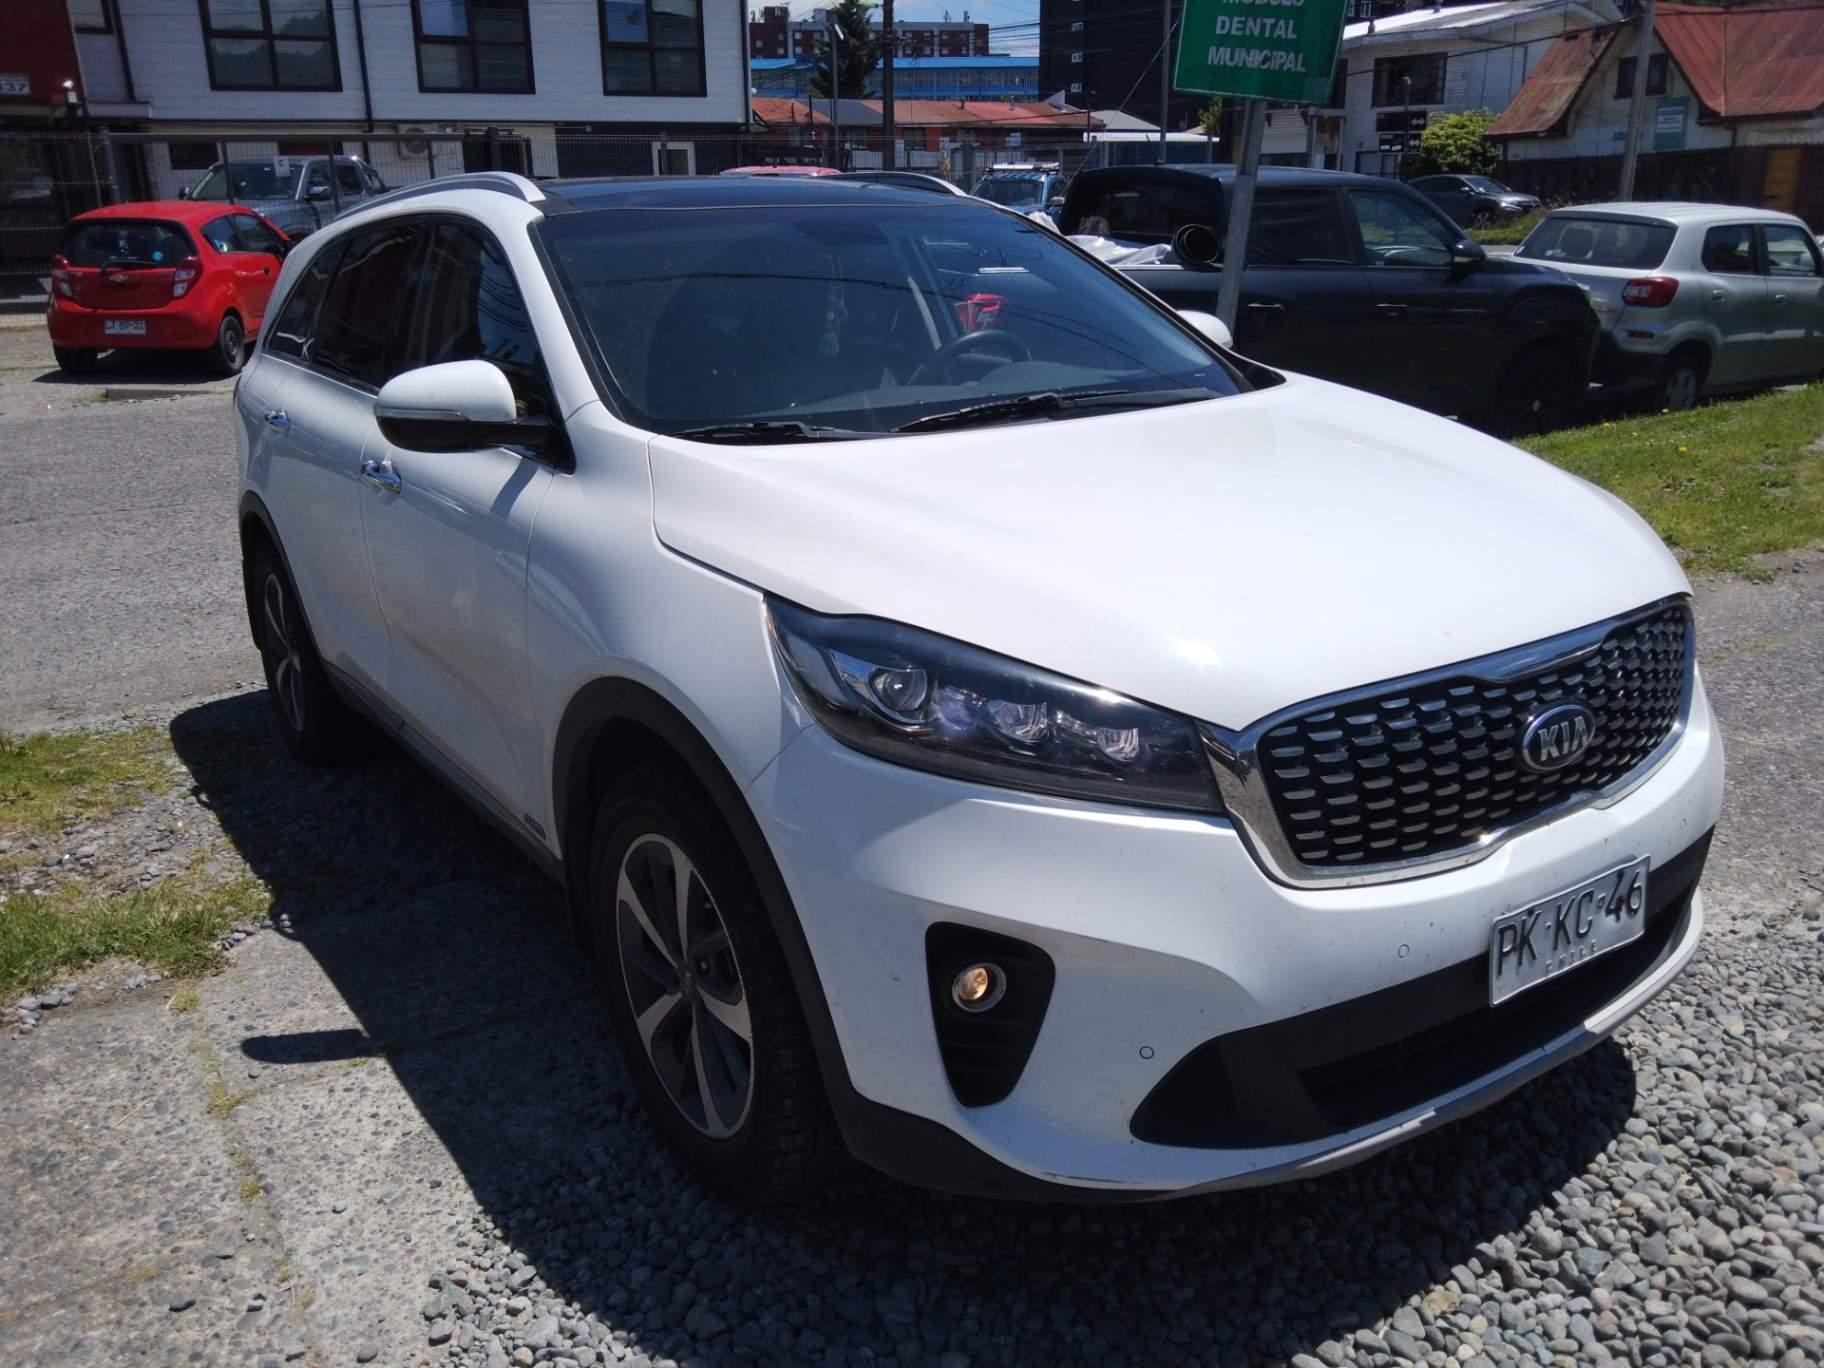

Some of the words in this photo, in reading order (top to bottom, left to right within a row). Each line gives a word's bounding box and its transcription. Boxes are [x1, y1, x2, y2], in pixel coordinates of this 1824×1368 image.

[1215, 15, 1298, 40] DENTAL
[1207, 46, 1307, 73] MUNICIPAL
[1537, 716, 1589, 762] KIA
